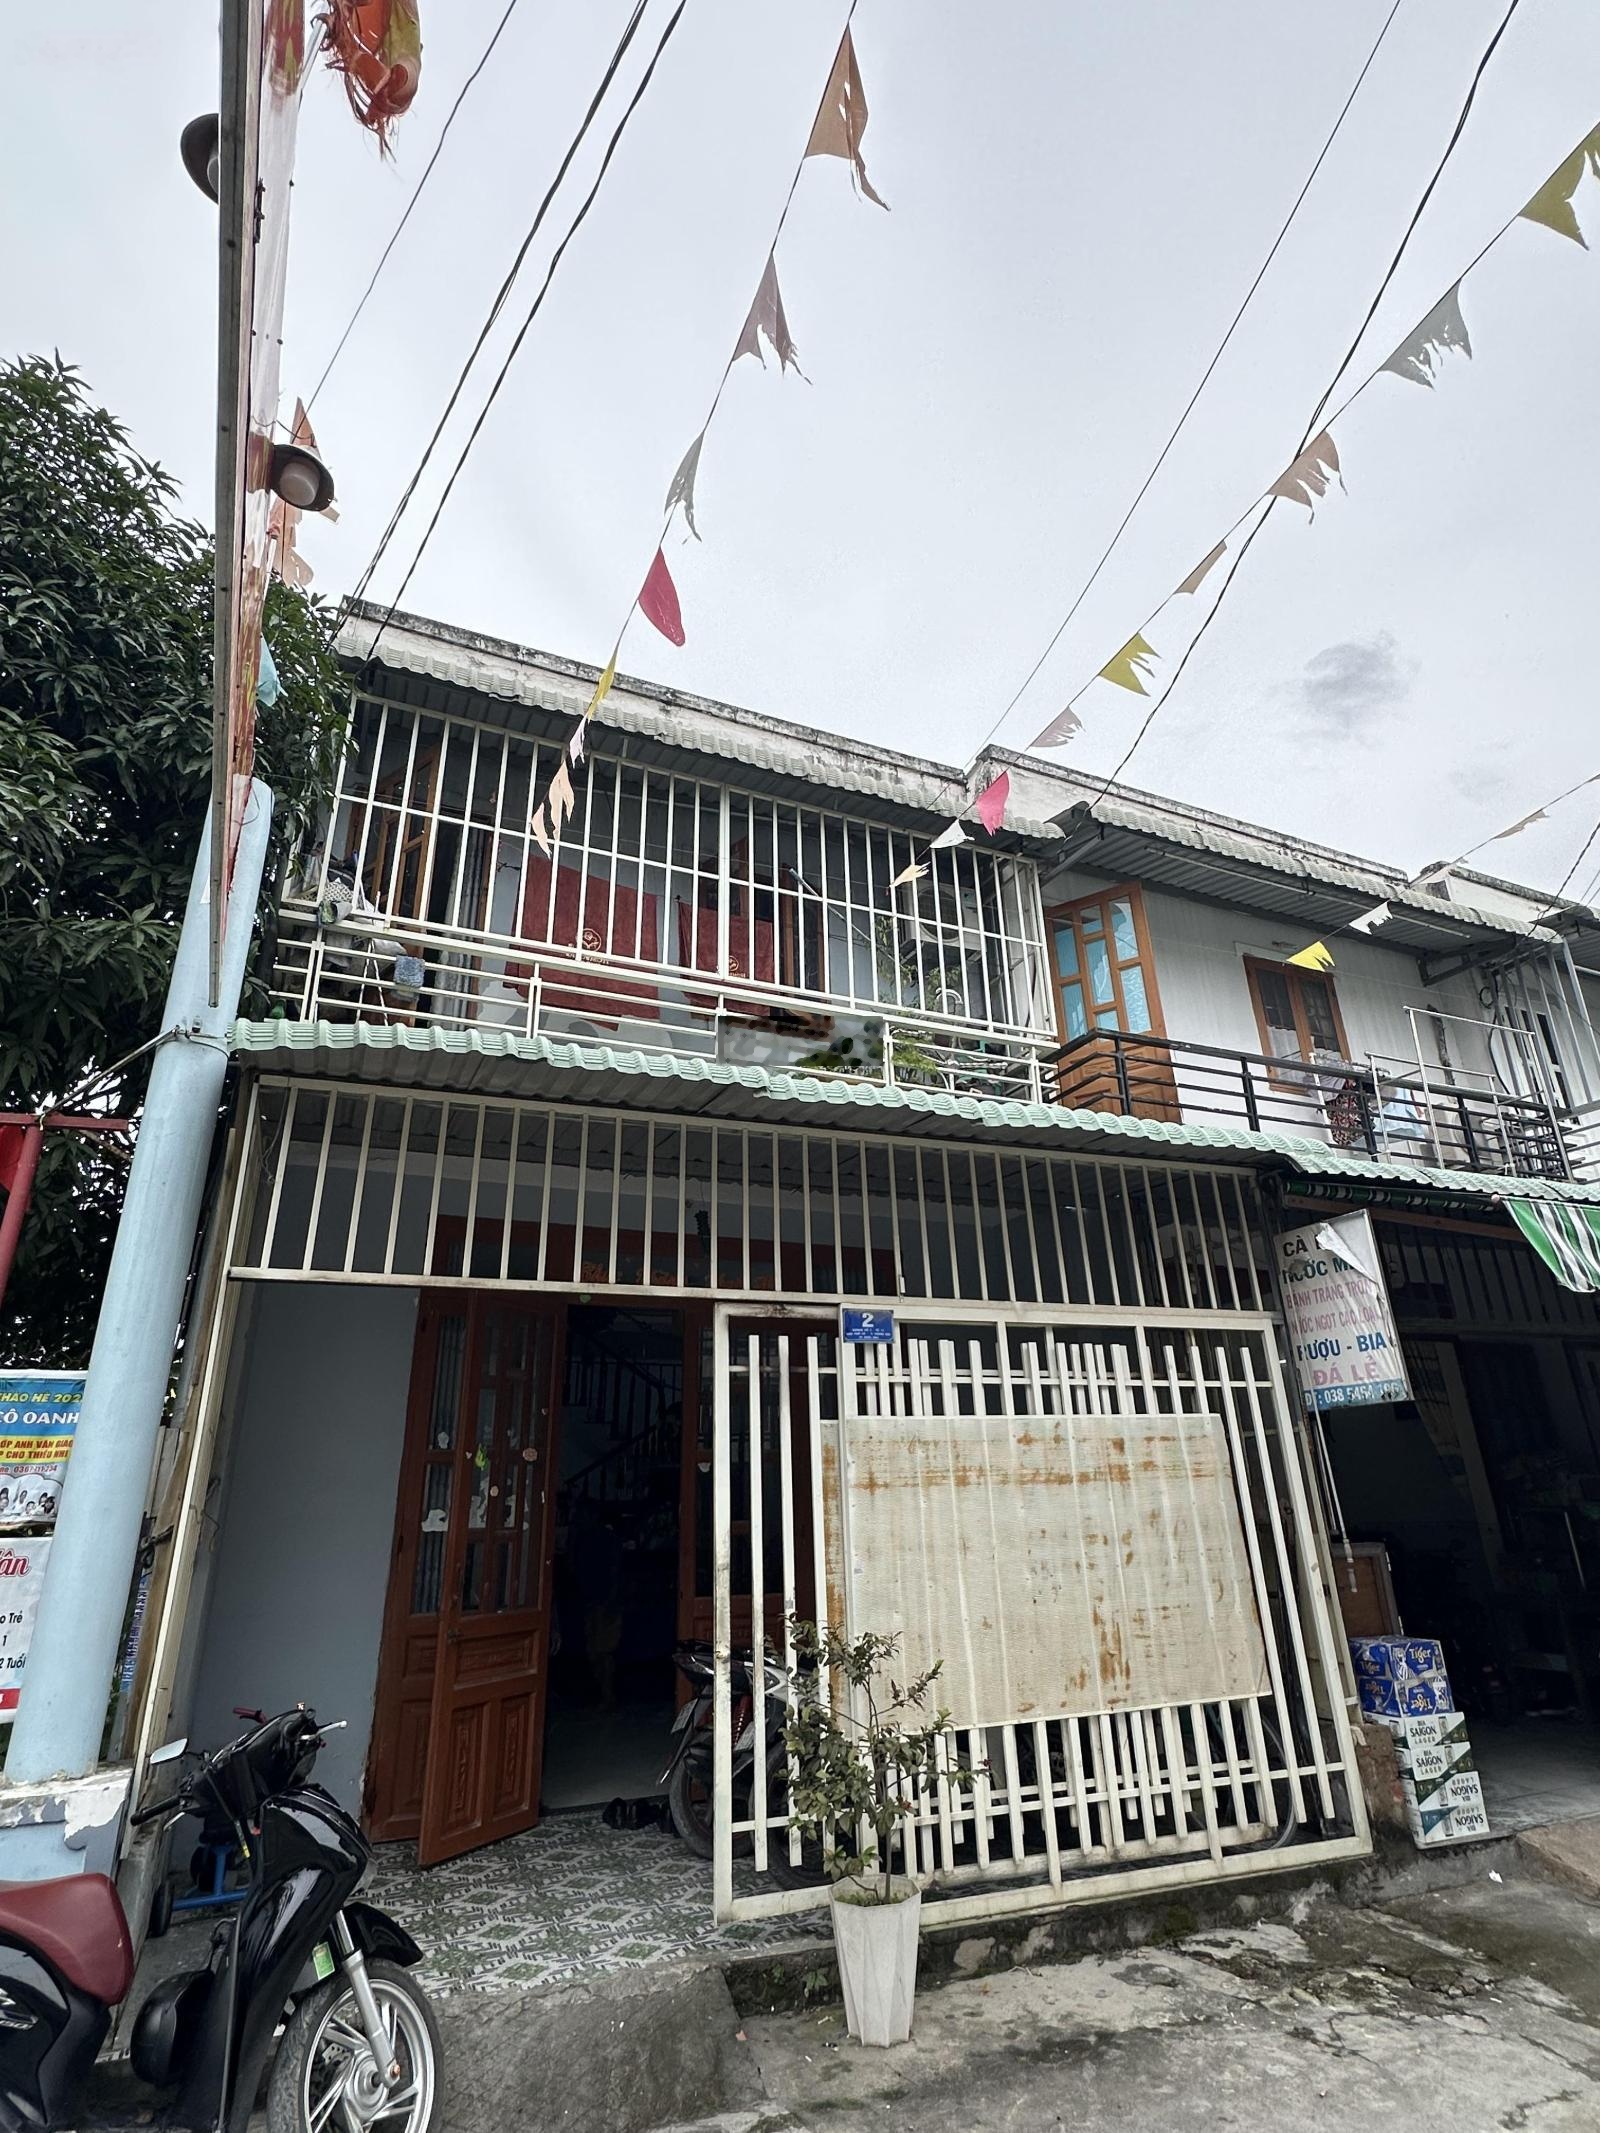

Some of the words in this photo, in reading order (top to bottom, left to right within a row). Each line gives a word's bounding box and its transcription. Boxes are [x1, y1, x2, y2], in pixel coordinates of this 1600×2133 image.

[1283, 1235, 1308, 1257] CÀ
[862, 1312, 874, 1328] 2
[1356, 1332, 1387, 1352] BIA
[1313, 1362, 1344, 1386] ĐÁ
[1351, 1354, 1380, 1381] LẺ
[1324, 1389, 1345, 1403] 038
[0, 1408, 19, 1424] Ô
[23, 1411, 80, 1424] OANH
[14, 1440, 33, 1449] ANH
[6, 1450, 25, 1459] CHO
[8, 1610, 23, 1624] Trẻ
[7, 1653, 26, 1669] Tuổi
[1409, 1647, 1431, 1663] Tiger
[1411, 1694, 1433, 1711] Tiger
[1410, 1726, 1437, 1738] SAIGON
[1416, 1755, 1443, 1767] SAIGON
[1451, 1784, 1479, 1796] SAIGON
[1455, 1814, 1484, 1827] SAIGON
